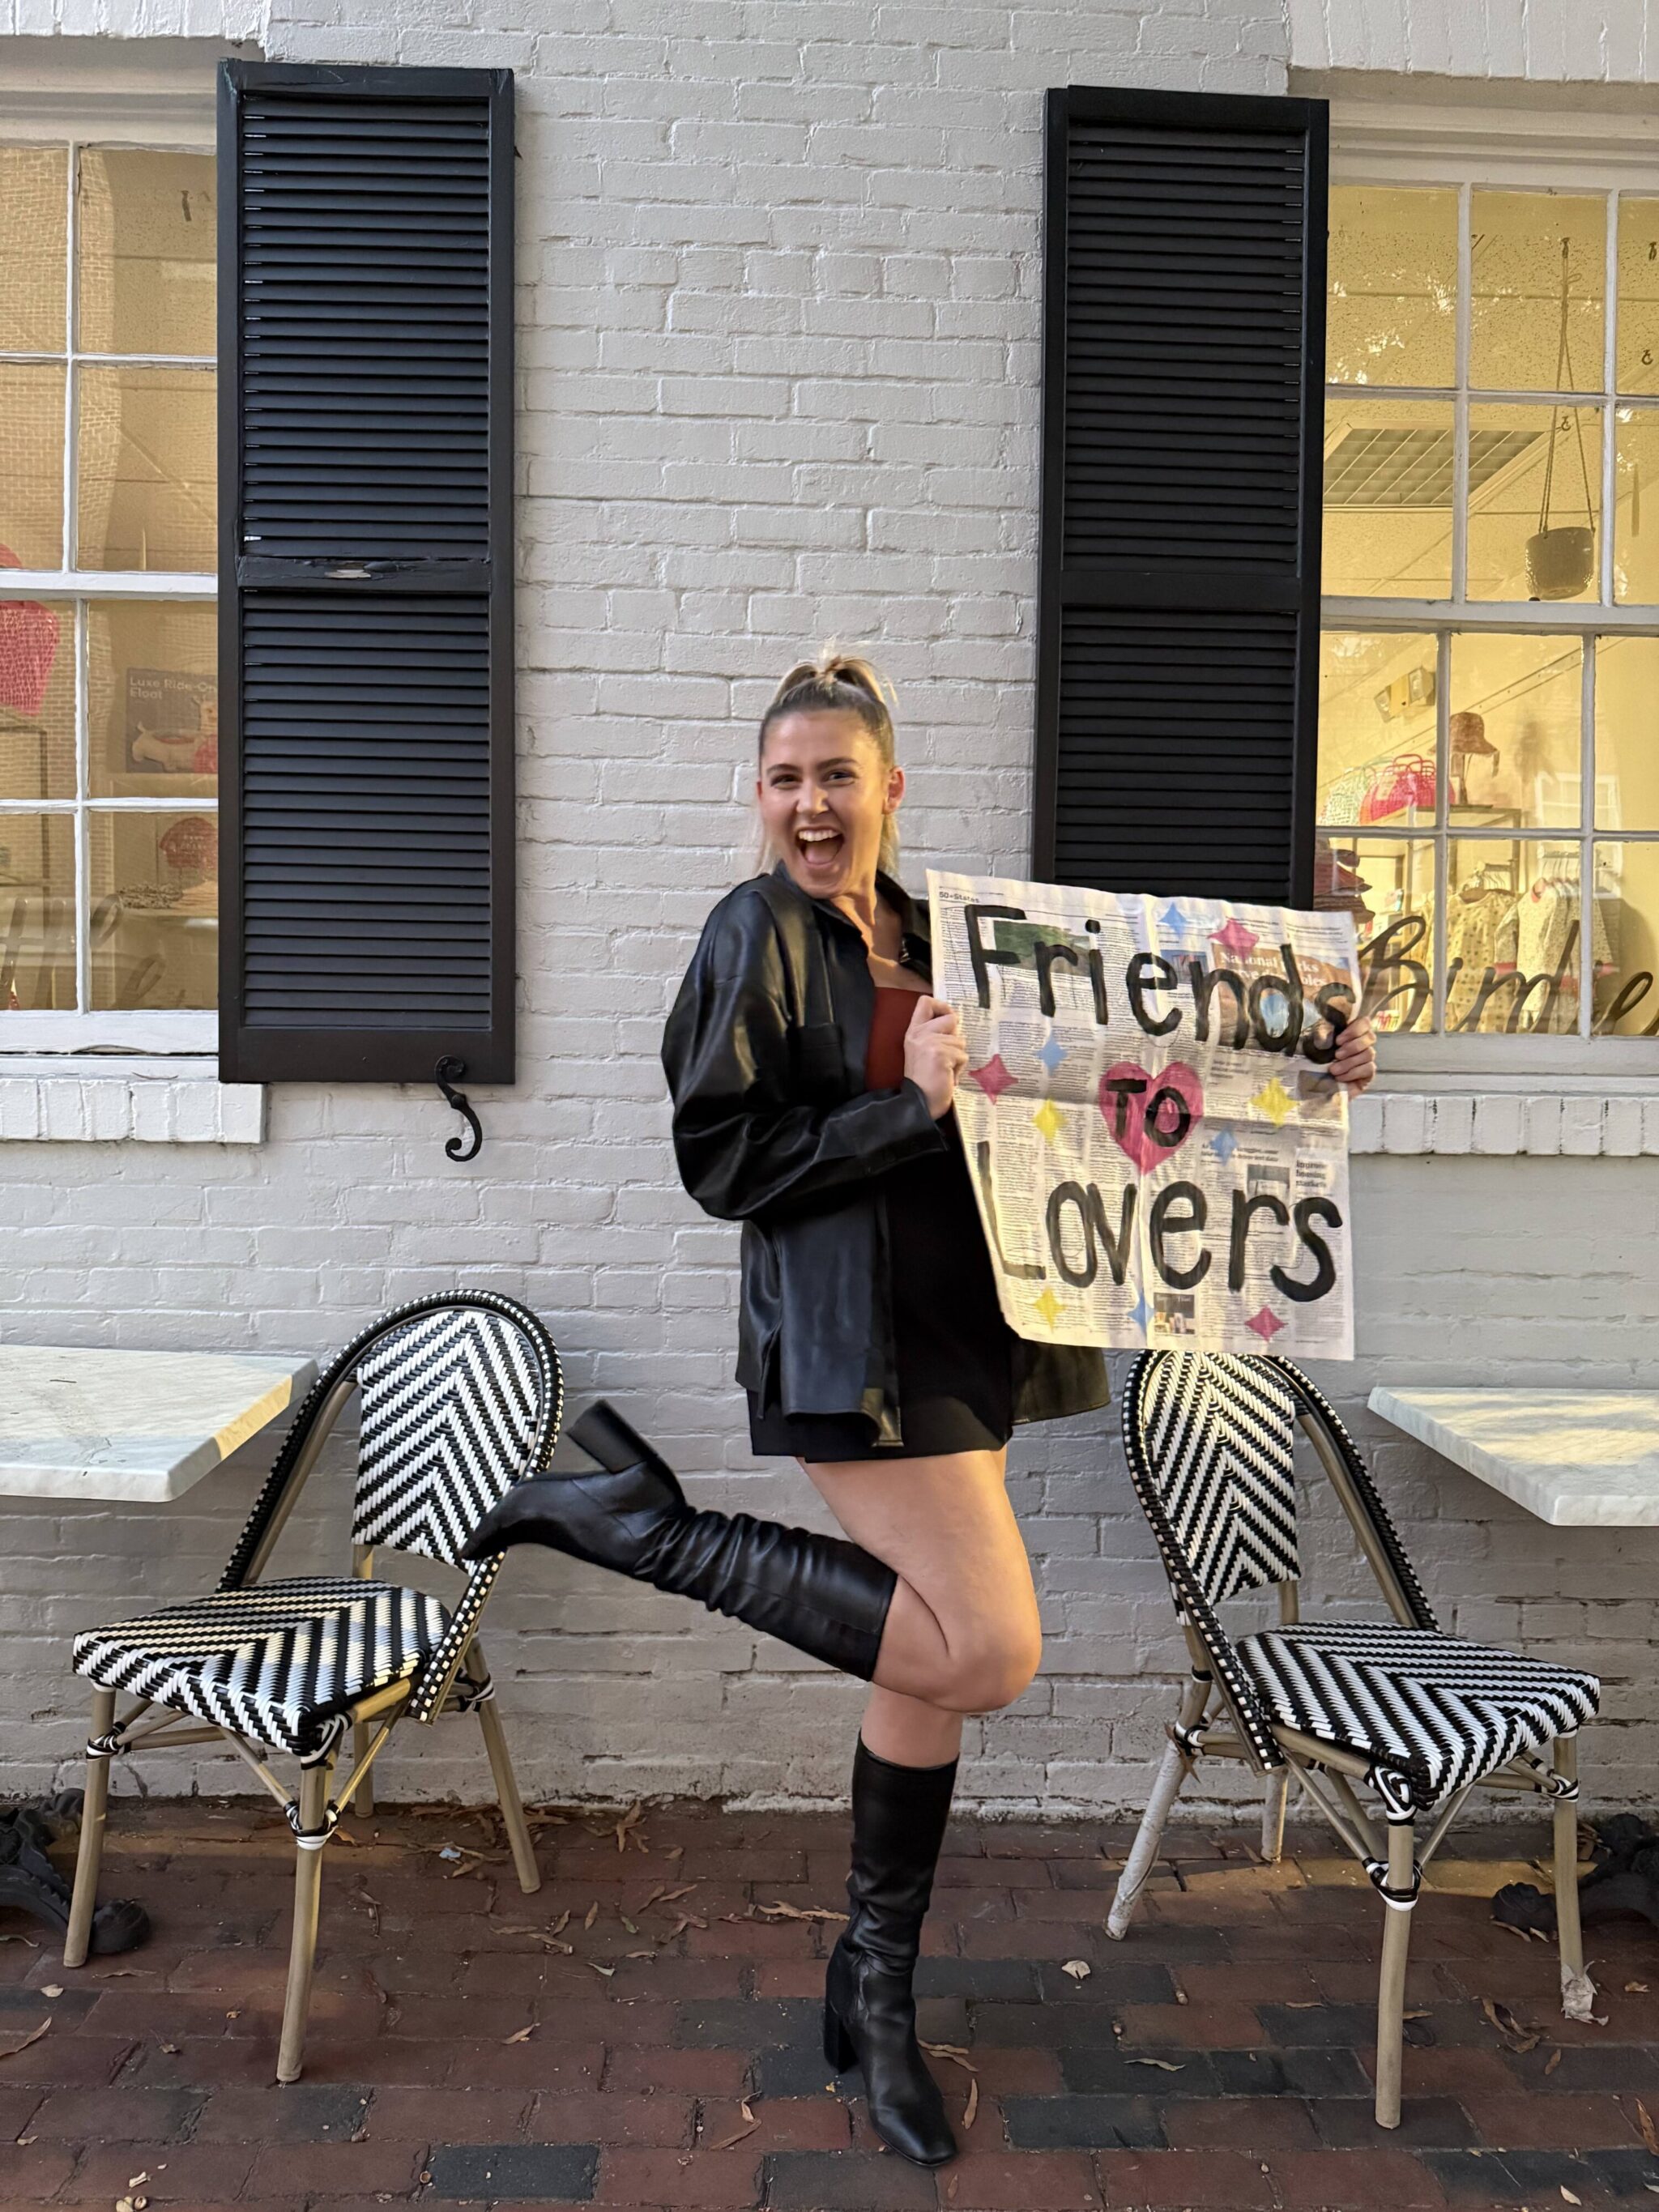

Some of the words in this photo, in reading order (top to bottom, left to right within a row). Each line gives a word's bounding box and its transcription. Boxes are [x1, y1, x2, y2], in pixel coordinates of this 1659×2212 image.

[130, 676, 161, 688] Luxe
[130, 687, 163, 700] Float
[1219, 952, 1277, 969] Naonal
[965, 904, 1356, 1064] Friends
[1106, 1078, 1192, 1148] TO
[977, 1140, 1343, 1302] Lovers
